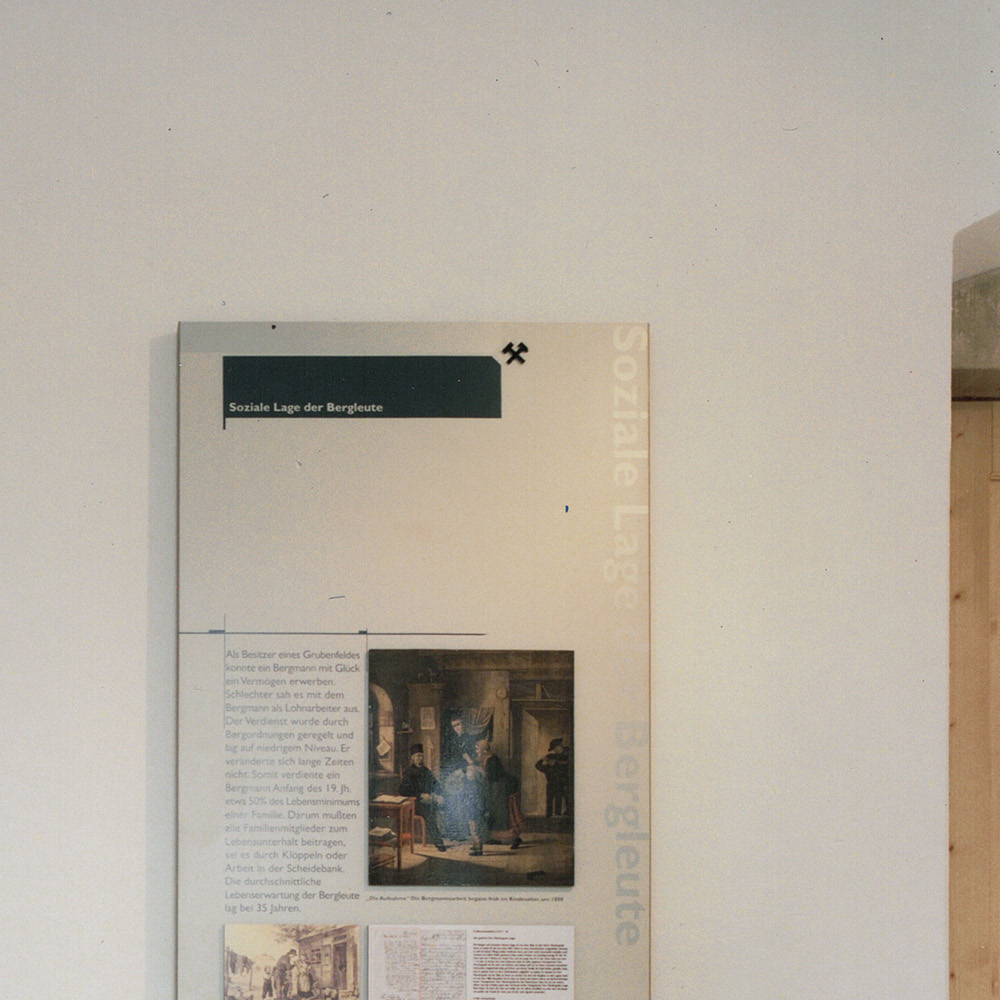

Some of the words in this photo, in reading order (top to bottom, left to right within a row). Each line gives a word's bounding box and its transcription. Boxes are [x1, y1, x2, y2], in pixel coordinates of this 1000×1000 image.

[229, 402, 270, 412] Soziale
[274, 403, 300, 414] Lage
[304, 402, 323, 412] der
[327, 402, 383, 414] Bergleute
[611, 325, 647, 487] Soziale
[603, 504, 647, 611] Lage
[226, 650, 239, 659] Als
[242, 650, 275, 659] Besitzer
[279, 651, 300, 659] eines
[303, 650, 360, 659] Grubenfeldes
[258, 664, 270, 672] ein
[273, 664, 316, 674] Bergmann
[319, 664, 332, 672] mit
[226, 677, 238, 685] ein
[289, 677, 335, 685] erwerben.
[226, 690, 272, 698] Schlechter
[276, 691, 290, 699] sah
[307, 691, 321, 699] mit
[324, 691, 344, 699] dem
[226, 704, 269, 714] Bergmann
[271, 704, 282, 712] als
[285, 704, 340, 712] Lohnarbeiter
[225, 717, 242, 725] Der
[245, 717, 288, 725] Verdienst
[290, 717, 319, 725] wurde
[323, 717, 348, 726] durch
[226, 731, 294, 741] Bergordnungen
[297, 731, 333, 741] geregelt
[337, 731, 353, 739] und
[226, 744, 238, 754] lag
[241, 744, 254, 752] auf
[257, 744, 301, 754] niedrigem
[305, 744, 338, 752] Niveau.
[341, 744, 350, 752] Er
[278, 757, 295, 765] sich
[299, 757, 321, 767] lange
[325, 757, 354, 766] Zeiten
[252, 771, 278, 779] Somit
[281, 771, 323, 779] verdiente
[327, 771, 340, 779] ein
[225, 784, 270, 794] Bergmann
[273, 784, 304, 794] Anfang
[307, 784, 322, 792] des
[326, 784, 339, 792] 19.
[340, 784, 351, 794] Jh.
[249, 798, 267, 806] 50%
[269, 798, 284, 806] des
[286, 798, 360, 806] Lebensminimums
[225, 811, 248, 819] einer
[252, 811, 285, 819] Familie.
[288, 811, 319, 819] Darum
[322, 811, 356, 820] mußten
[243, 824, 326, 834] Familienmitglieder
[603, 721, 647, 948] Bergleute
[225, 838, 298, 846] Lebensunterhalt
[253, 851, 279, 859] durch
[326, 852, 348, 860] oder
[225, 864, 254, 872] Arbeit
[287, 864, 344, 873] Scheidebank.
[225, 877, 241, 885] Die
[244, 877, 321, 886] durchschnittliche
[225, 890, 299, 901] Lebenserwartung
[302, 891, 316, 899] der
[319, 891, 360, 901] Bergleute
[225, 904, 237, 914] lag
[240, 904, 254, 912] bei
[257, 904, 267, 912] 35
[270, 904, 301, 914] Jahren.
